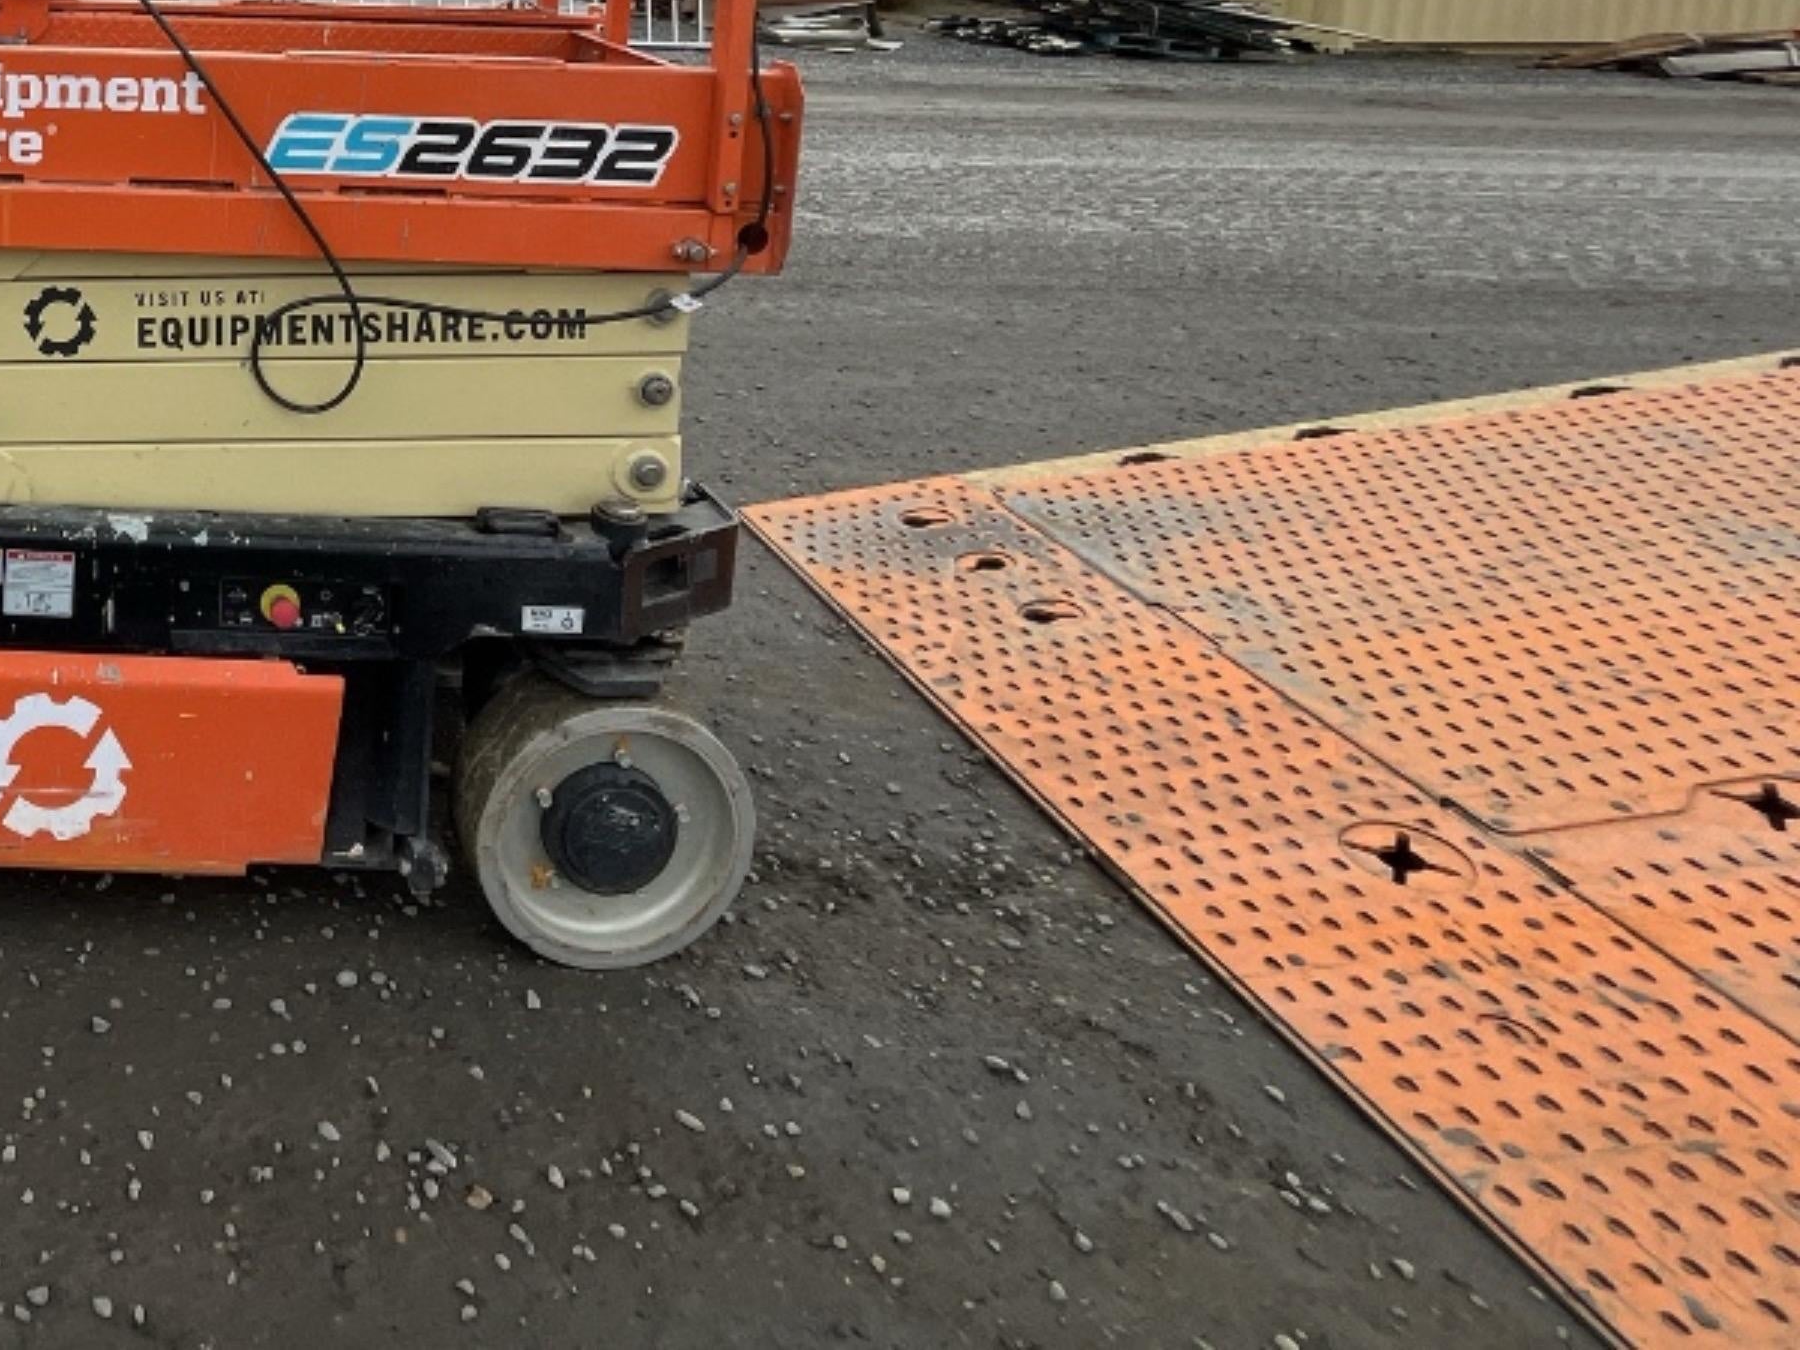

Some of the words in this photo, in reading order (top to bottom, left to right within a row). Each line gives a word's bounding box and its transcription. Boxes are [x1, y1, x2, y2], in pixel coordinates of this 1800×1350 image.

[264, 112, 679, 186] ES2632
[135, 290, 190, 307] VISIT
[200, 290, 225, 306] US
[137, 308, 587, 351] EQUIPMENTSHARE.COM
